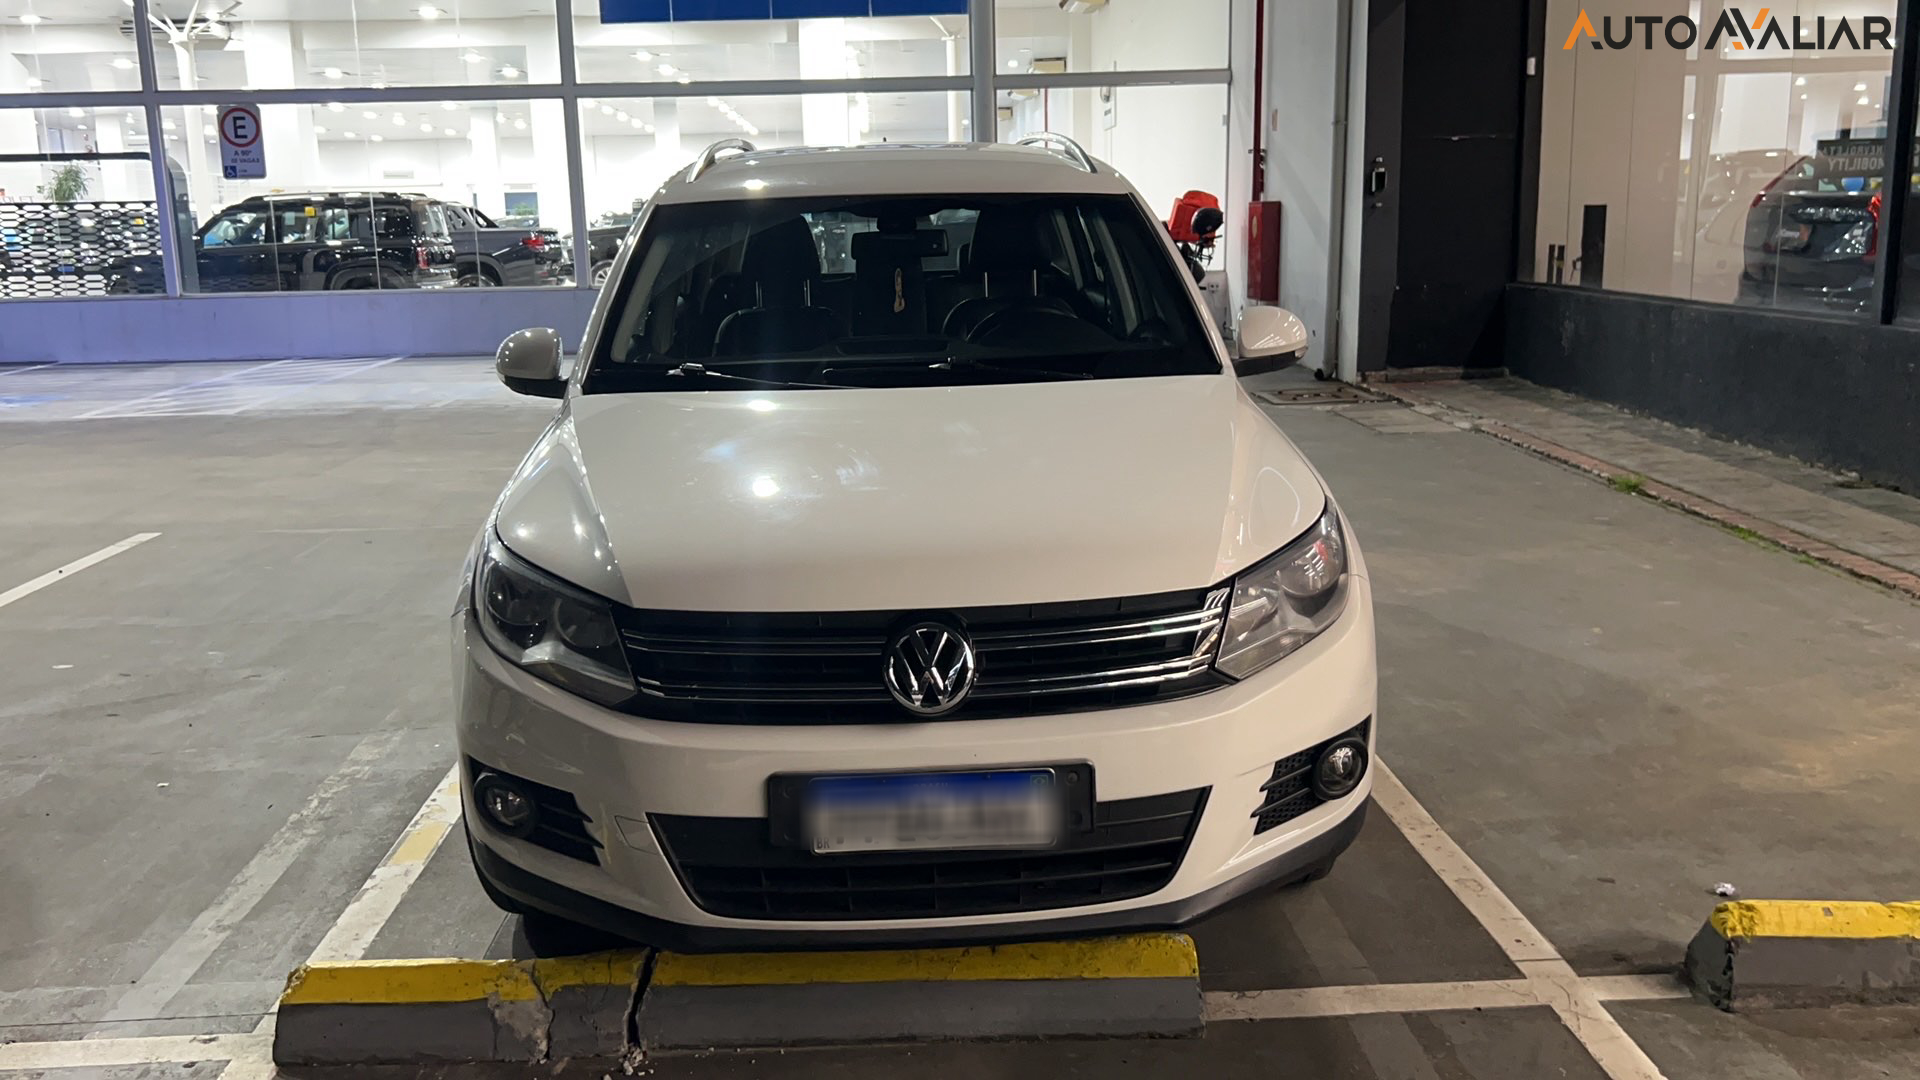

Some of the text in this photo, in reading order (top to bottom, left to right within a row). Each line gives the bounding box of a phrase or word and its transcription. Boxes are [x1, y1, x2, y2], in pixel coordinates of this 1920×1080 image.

[233, 116, 248, 139] E
[886, 624, 973, 712] VW
[816, 837, 830, 849] BR
